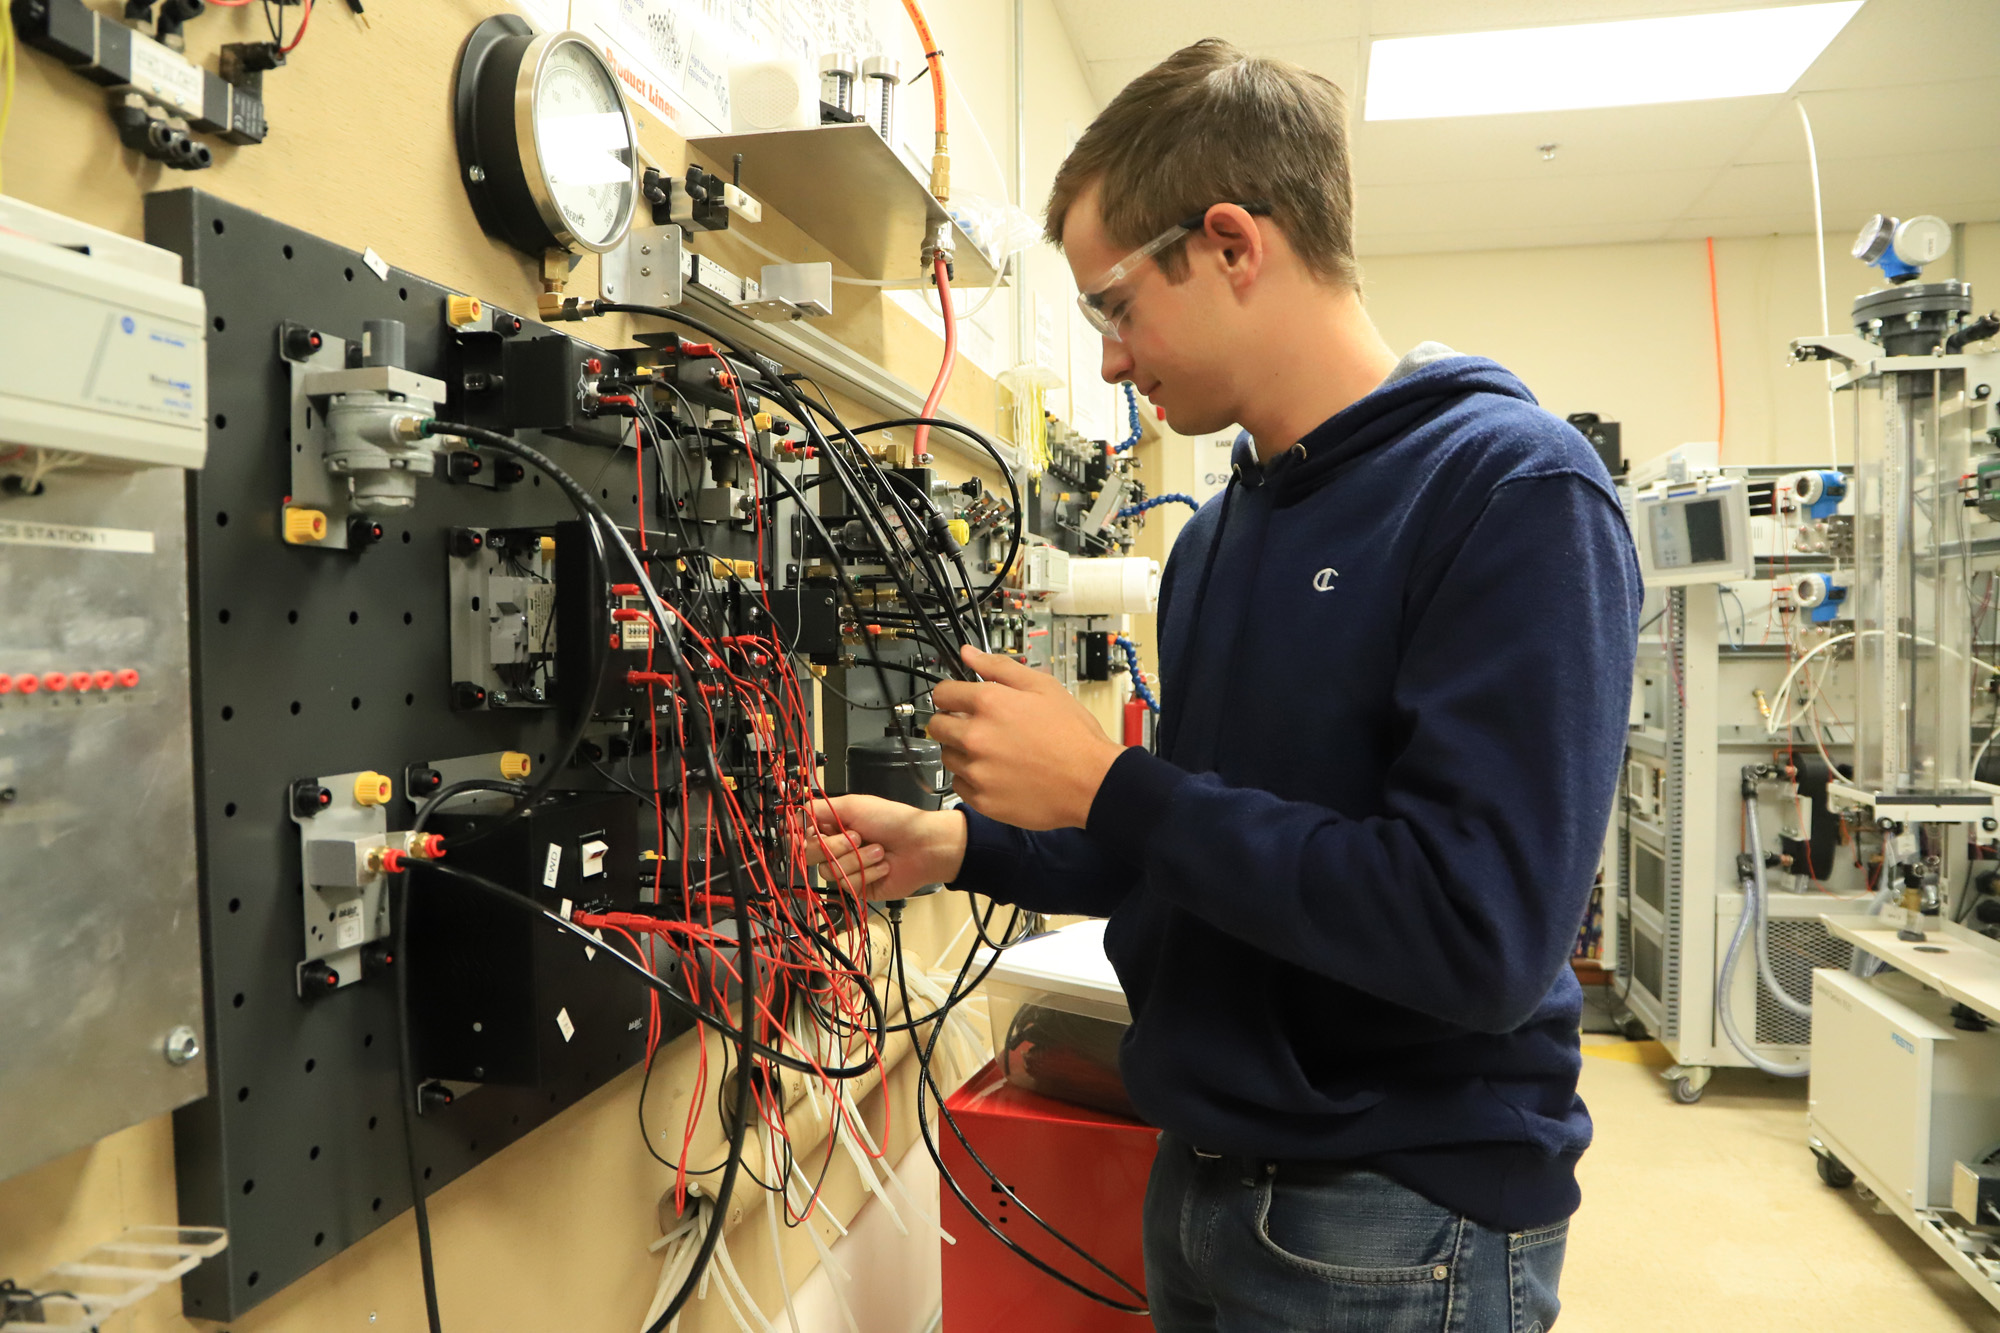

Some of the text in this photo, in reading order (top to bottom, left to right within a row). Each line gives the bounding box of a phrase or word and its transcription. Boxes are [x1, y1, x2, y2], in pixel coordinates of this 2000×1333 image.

[605, 46, 677, 122] Product Lineu
[24, 526, 95, 543] STATION
[547, 850, 559, 882] FWD
